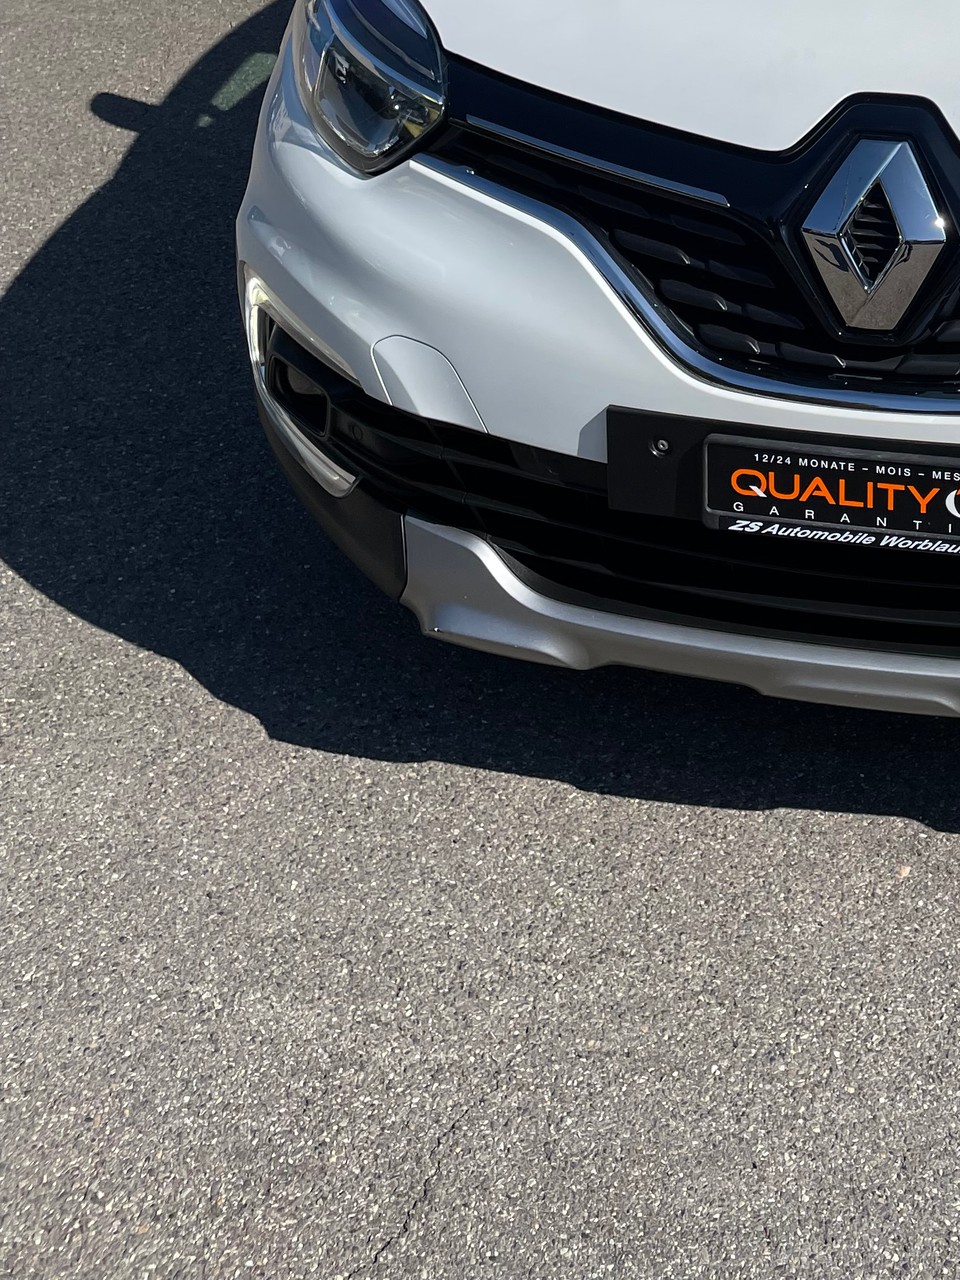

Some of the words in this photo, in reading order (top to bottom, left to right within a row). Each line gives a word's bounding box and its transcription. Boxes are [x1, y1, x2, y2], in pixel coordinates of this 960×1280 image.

[754, 453, 791, 465] 12/24
[799, 458, 855, 471] MONATE
[876, 465, 911, 477] MOIS
[730, 468, 941, 514] QUALITY
[728, 520, 763, 533] ZS
[762, 524, 876, 546] Automobile
